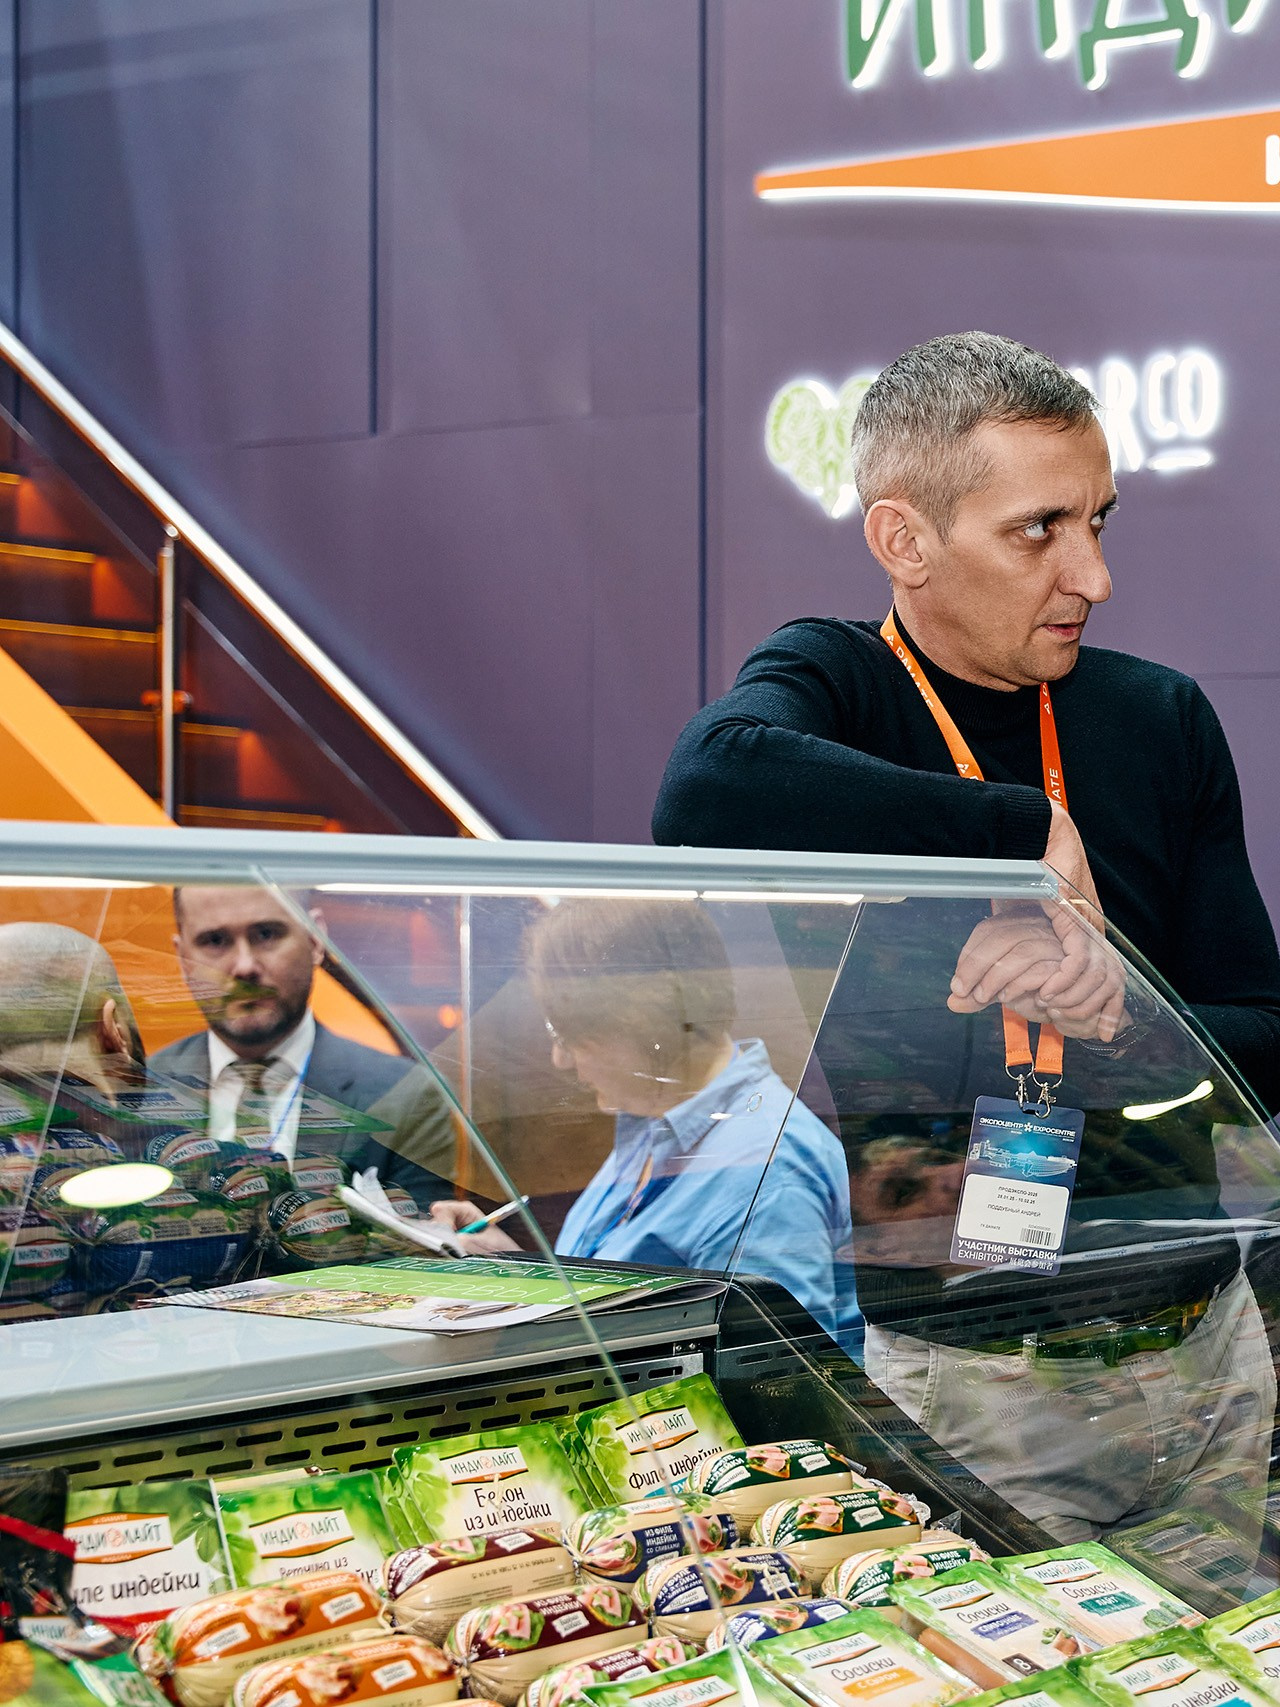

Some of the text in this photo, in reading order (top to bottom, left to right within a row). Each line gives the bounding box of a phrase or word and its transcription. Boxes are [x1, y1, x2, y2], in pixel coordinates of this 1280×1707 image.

[1072, 352, 1220, 474] RCO
[1049, 768, 1063, 804] ATE
[979, 1117, 1023, 1129] ЭКСПОЦЕНТР
[1033, 1125, 1076, 1137] EXPOCENTRE
[958, 1239, 1057, 1261] УЧАСТНИК ВЫСТАВКИ
[958, 1249, 1004, 1263] EXHIBITOR
[628, 1467, 667, 1490] Филе
[464, 1502, 552, 1532] из индейки
[644, 1524, 673, 1537] ИЗ ФИЛЕ
[646, 1533, 678, 1547] ИНДЕЙКИ
[334, 1557, 348, 1569] из
[928, 1550, 961, 1561] ИЗ ФИЛЕ
[934, 1558, 967, 1570] ИНДЕЙКИ
[111, 1572, 200, 1600] индейки
[1062, 1580, 1120, 1599] Сосиски
[956, 1602, 1012, 1625] Сосиски
[831, 1655, 897, 1682] Сосиски
[1012, 1658, 1032, 1671] 8
[1181, 1679, 1241, 1707] индейки
